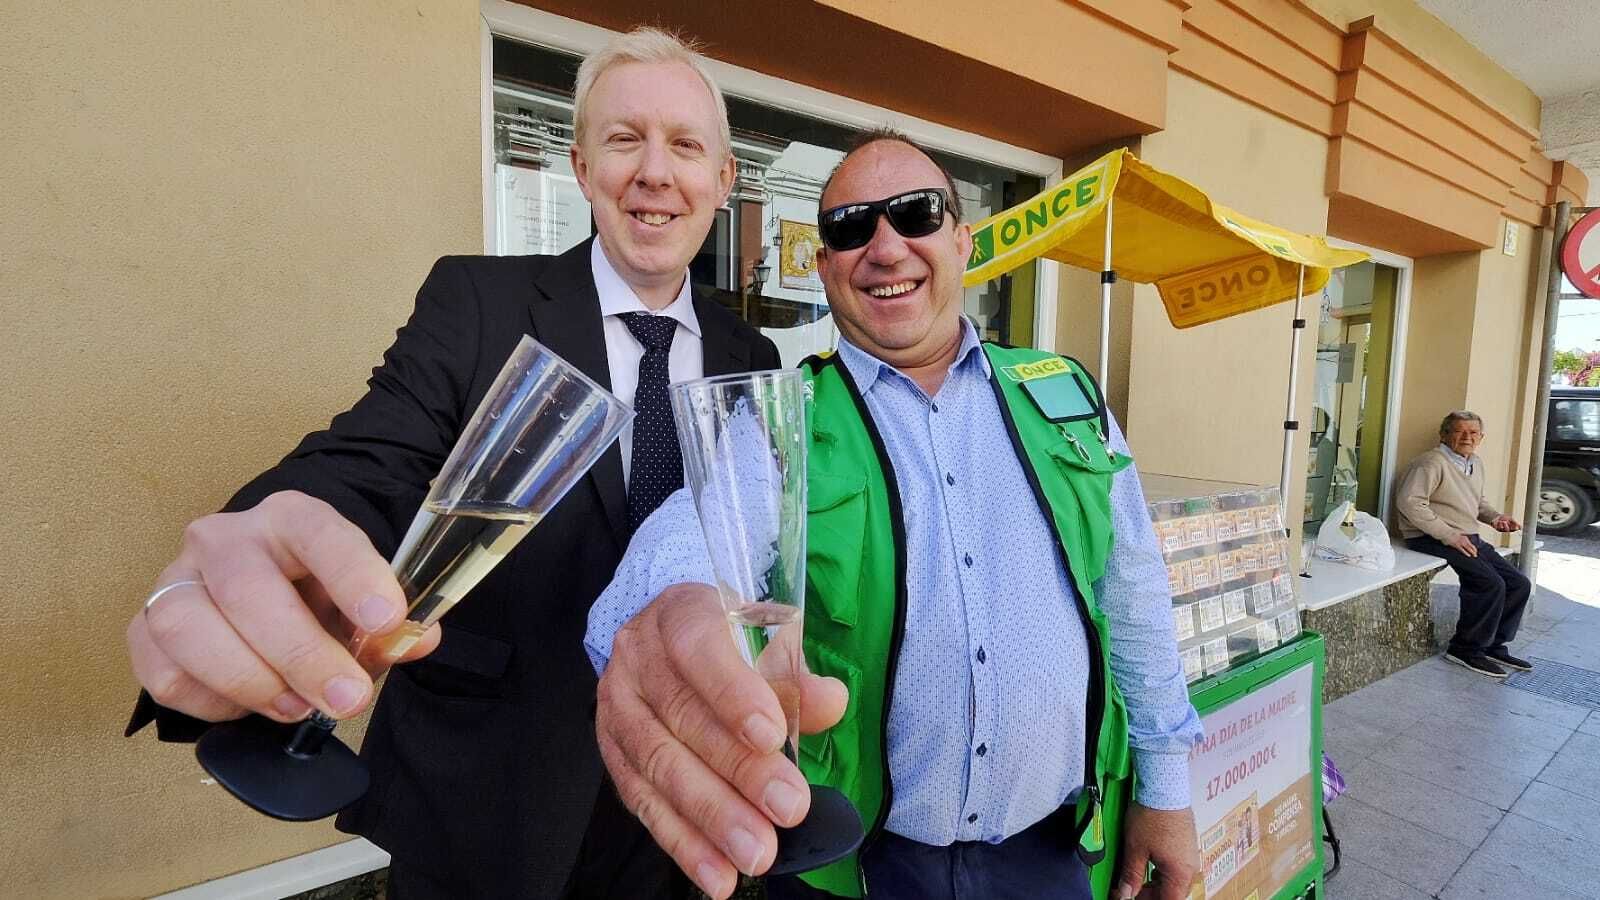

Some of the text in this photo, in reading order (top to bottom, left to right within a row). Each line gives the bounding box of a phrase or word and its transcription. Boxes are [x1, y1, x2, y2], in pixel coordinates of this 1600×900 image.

[1000, 174, 1099, 246] ONCE
[1021, 360, 1065, 376] ONCE
[1240, 713, 1253, 733] DE
[1254, 708, 1266, 724] LA
[1206, 742, 1277, 801] 17.000.000€
